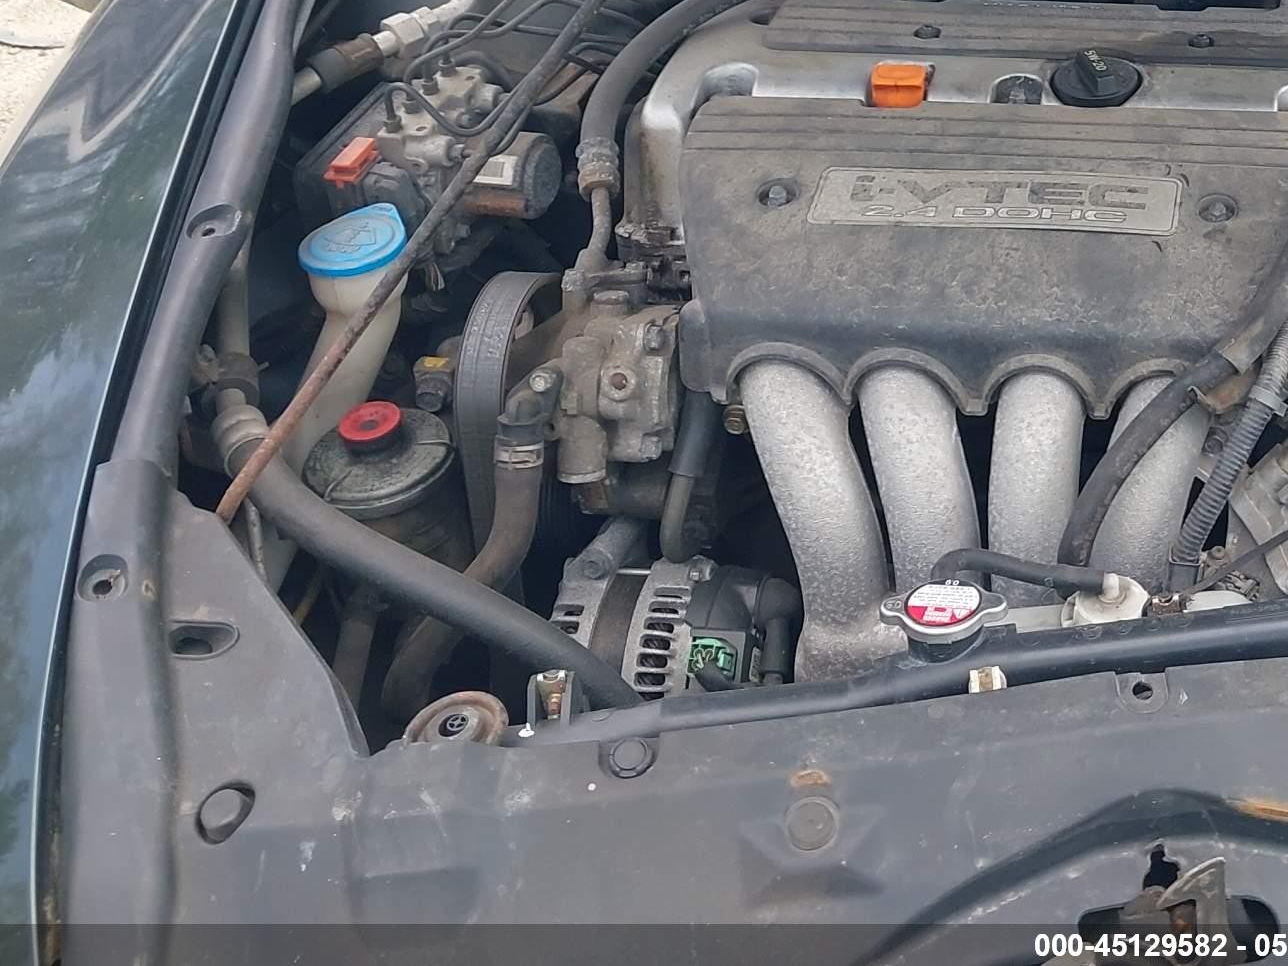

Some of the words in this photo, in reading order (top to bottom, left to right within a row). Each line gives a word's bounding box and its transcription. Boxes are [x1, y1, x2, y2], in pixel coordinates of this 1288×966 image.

[1083, 49, 1108, 71] 5W-20
[861, 204, 937, 218] 2.4
[953, 206, 1128, 223] DOHC
